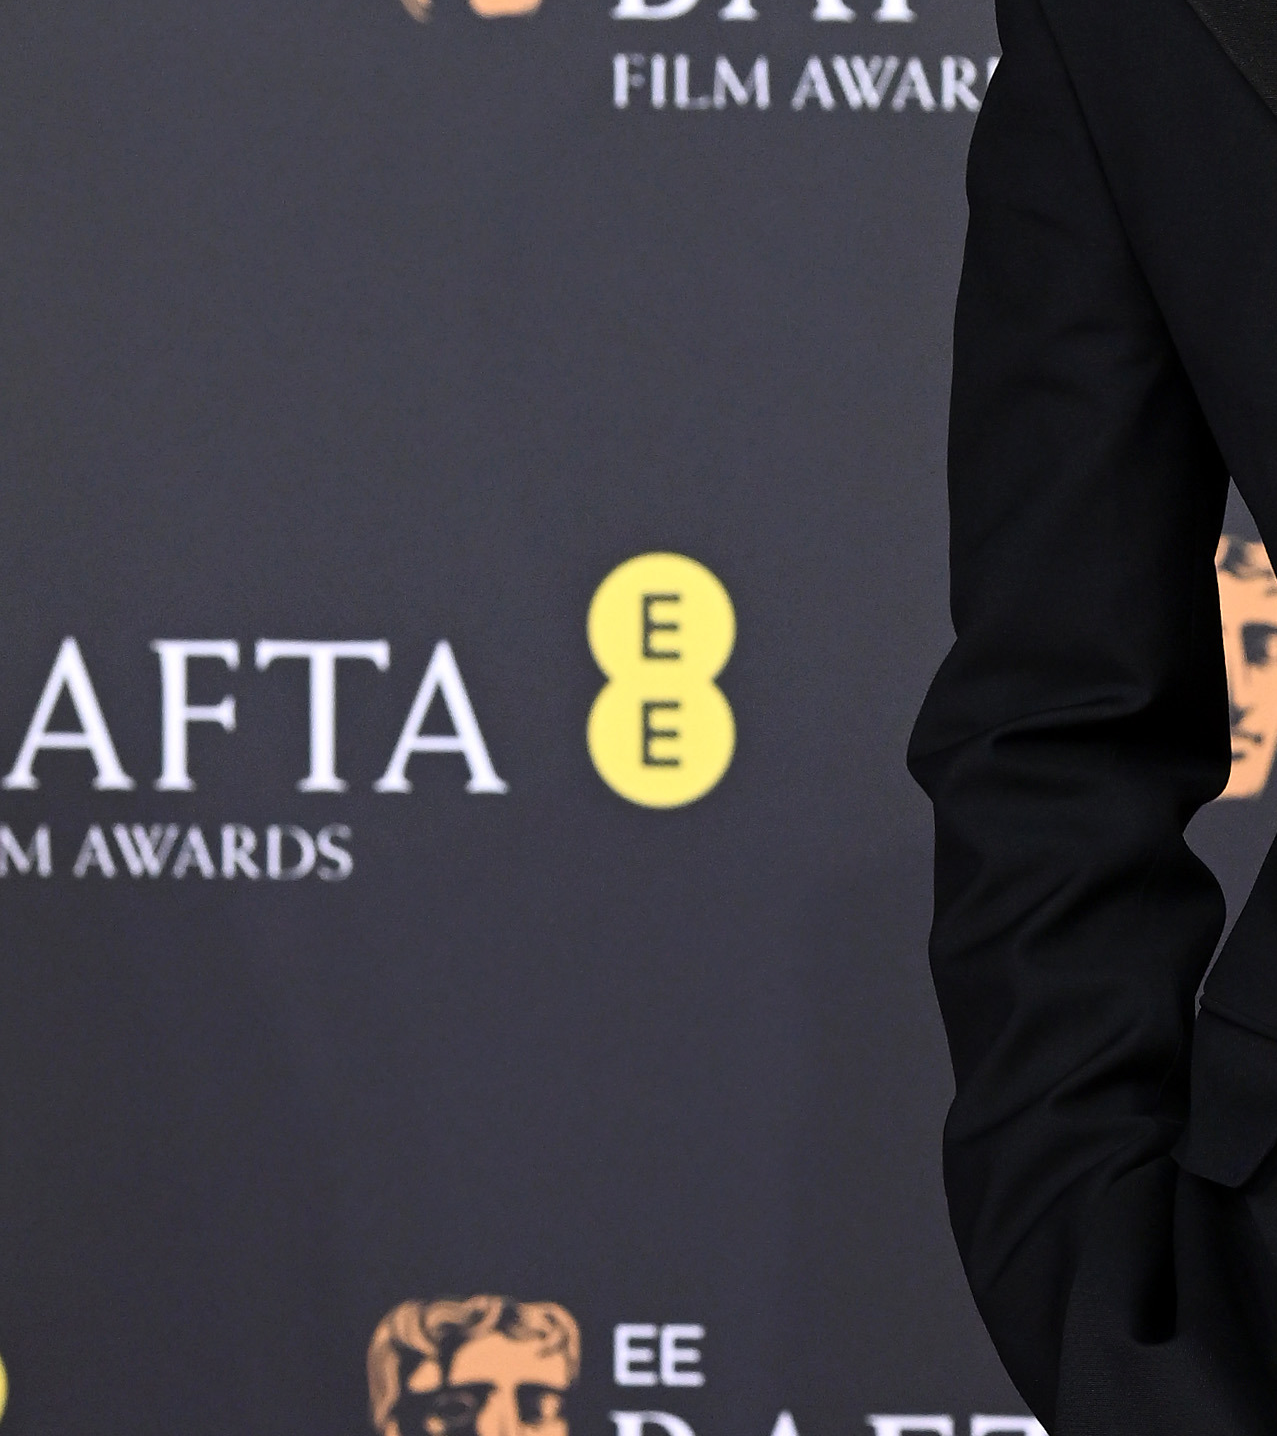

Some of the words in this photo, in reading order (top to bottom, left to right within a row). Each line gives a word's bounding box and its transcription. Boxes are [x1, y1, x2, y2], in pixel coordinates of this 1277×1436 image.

[613, 53, 770, 109] FILM
[792, 56, 1000, 111] AWAR
[3, 637, 507, 794] AFTA
[75, 824, 353, 879] AWARDS
[614, 1324, 705, 1386] EE
